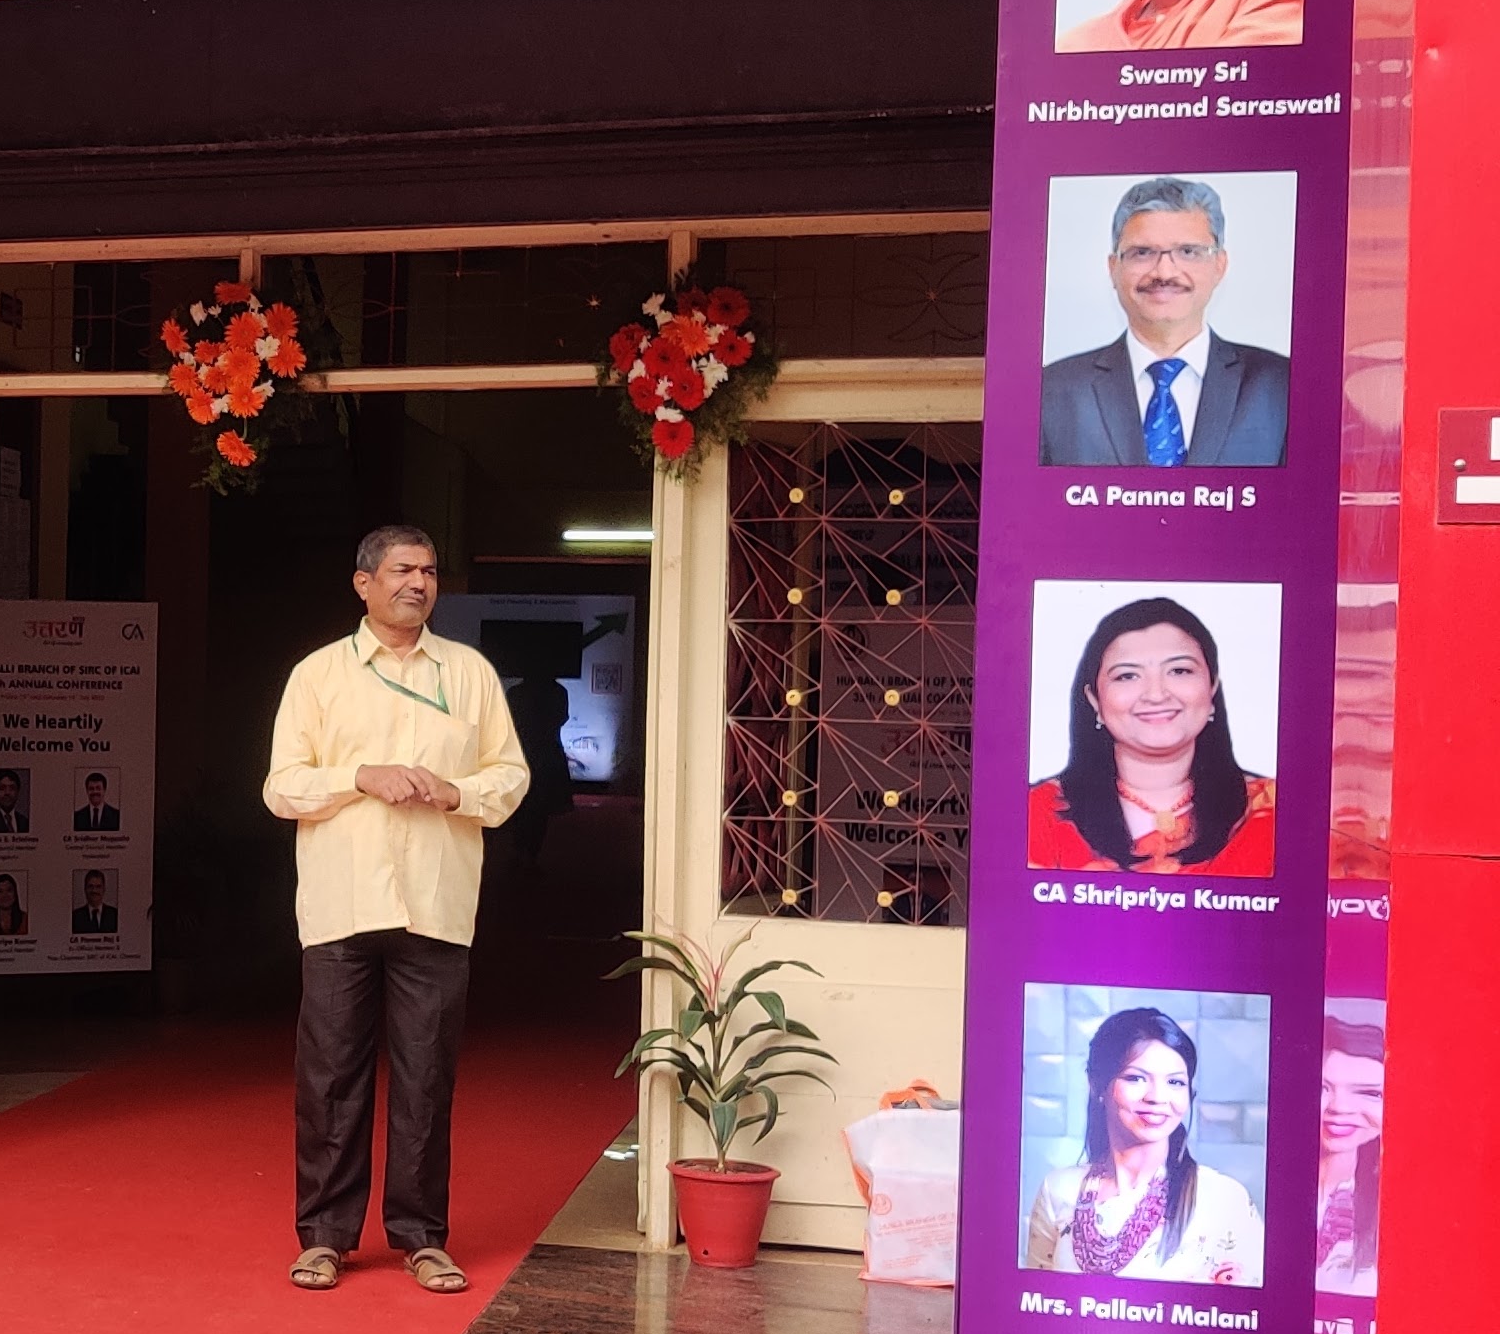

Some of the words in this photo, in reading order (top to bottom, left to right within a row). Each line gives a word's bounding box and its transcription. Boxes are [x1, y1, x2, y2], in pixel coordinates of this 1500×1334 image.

[1119, 64, 1207, 87] Swamy
[1214, 60, 1248, 83] Sri
[1028, 96, 1209, 124] Nirbhayanand
[1215, 93, 1341, 117] Saraswati
[1065, 485, 1099, 507] CA
[1106, 485, 1185, 507] Panna
[1193, 485, 1234, 511] Raj
[1241, 486, 1256, 507] S
[18, 664, 60, 675] BRANCH
[63, 665, 76, 675] OF
[104, 666, 116, 676] OF
[120, 666, 140, 676] ICAI
[8, 679, 53, 689] ANNUAL
[56, 680, 123, 690] CONFERENCE
[3, 714, 29, 729] We
[35, 714, 103, 733] Heartily
[79, 738, 111, 752] You
[1033, 882, 1066, 904] CA
[1073, 883, 1186, 913] Shripriya
[1193, 889, 1279, 912] Kumar
[1020, 1292, 1073, 1317] Mrs.
[1080, 1296, 1164, 1324] Pallavi
[1171, 1304, 1258, 1332] Malani
